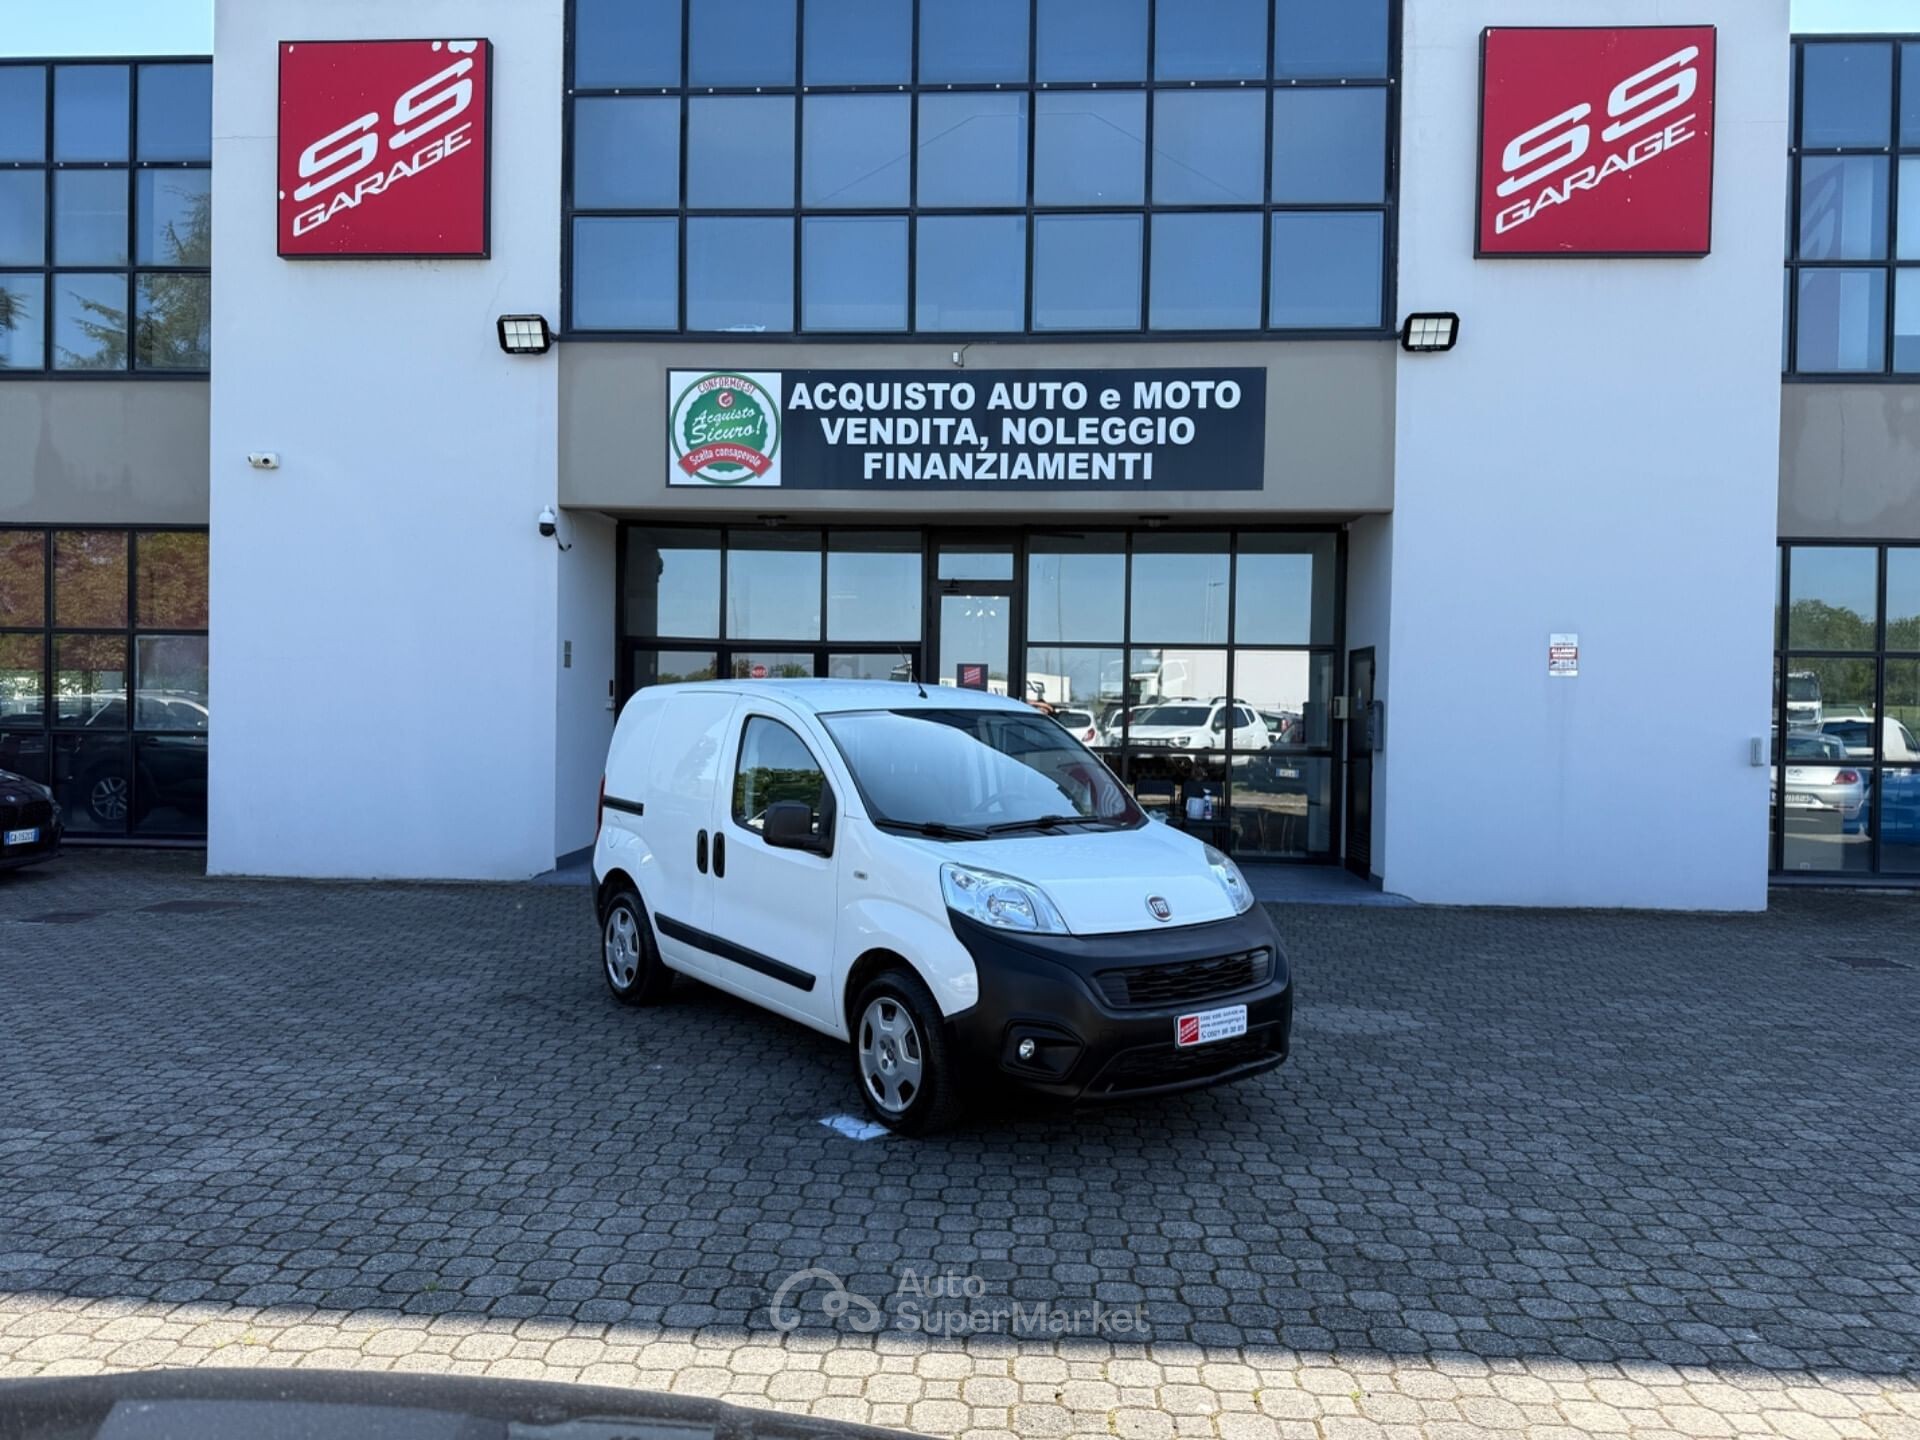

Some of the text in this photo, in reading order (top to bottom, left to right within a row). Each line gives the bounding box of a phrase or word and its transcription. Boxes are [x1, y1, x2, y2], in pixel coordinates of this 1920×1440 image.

[292, 121, 472, 237] GARAGE
[1495, 113, 1696, 235] GARAGE
[788, 381, 1242, 412] ACQUISTO AUTO e MOTO
[692, 407, 756, 427] Acquisto
[820, 416, 1195, 450] VENDITA, NOLEGGIO
[863, 451, 1154, 481] FINANZIAMENTI
